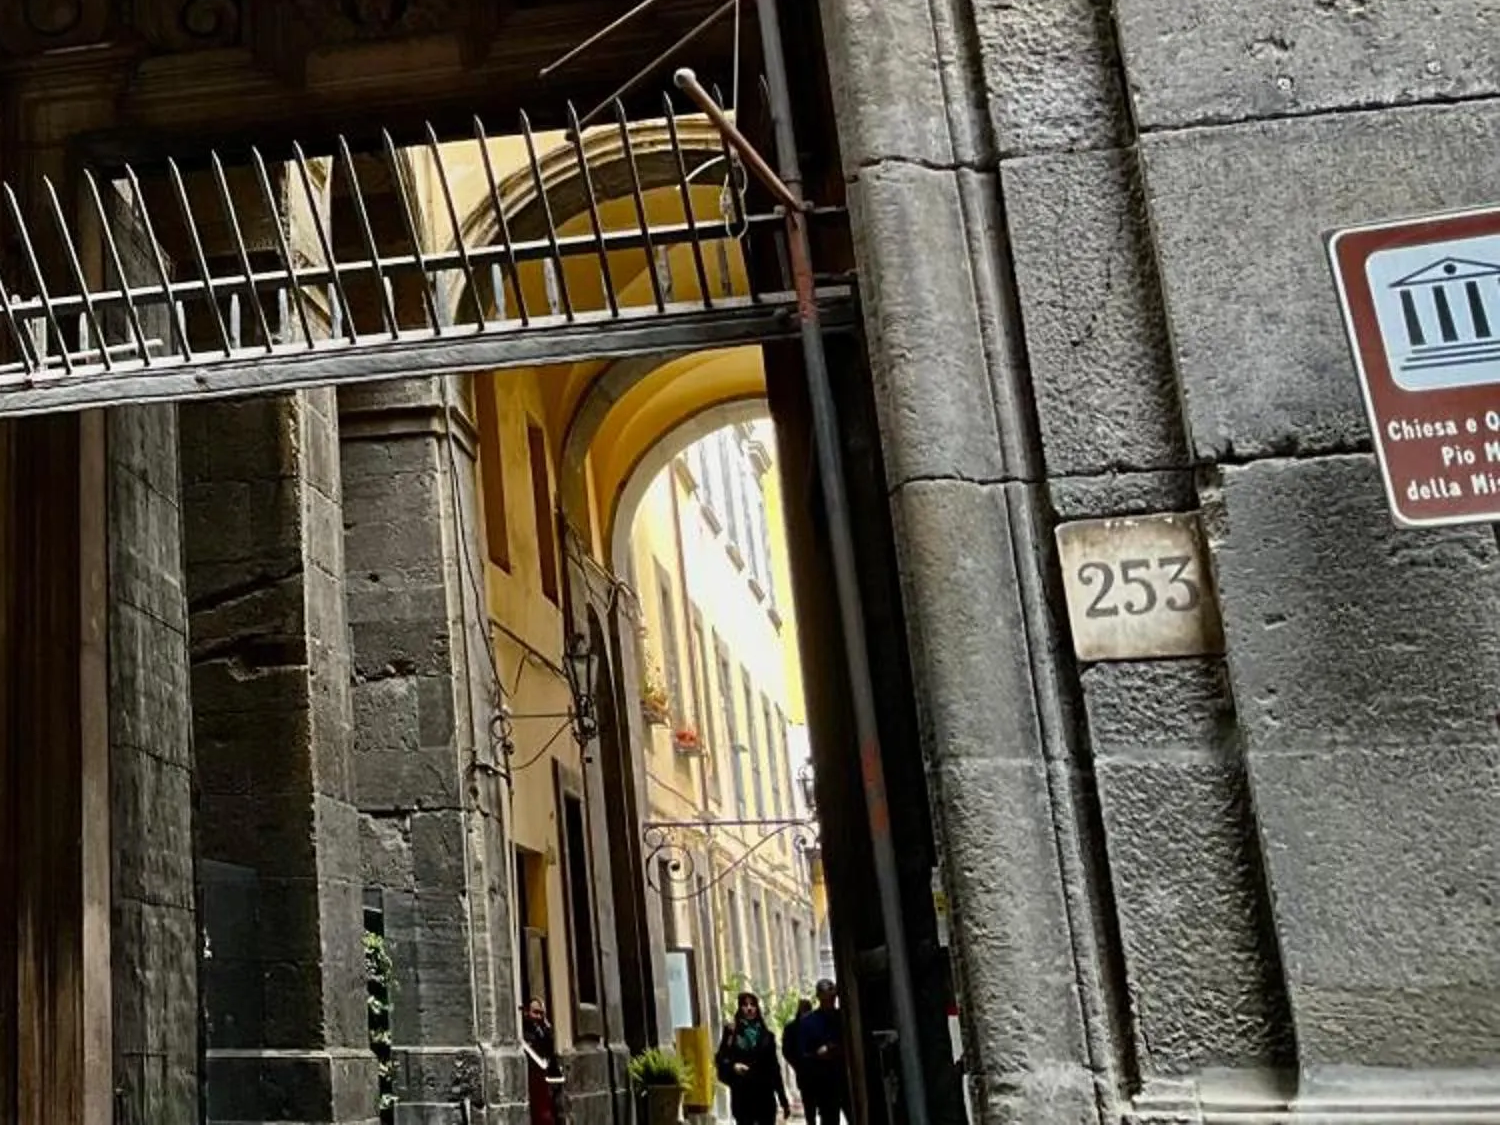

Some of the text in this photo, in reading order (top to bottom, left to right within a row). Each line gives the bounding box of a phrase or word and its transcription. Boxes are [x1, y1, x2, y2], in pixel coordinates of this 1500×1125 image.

[1387, 419, 1458, 441] Chiesa
[1466, 418, 1477, 433] e
[1441, 445, 1476, 467] Pio
[1407, 477, 1462, 501] della
[1077, 555, 1200, 619] 253
